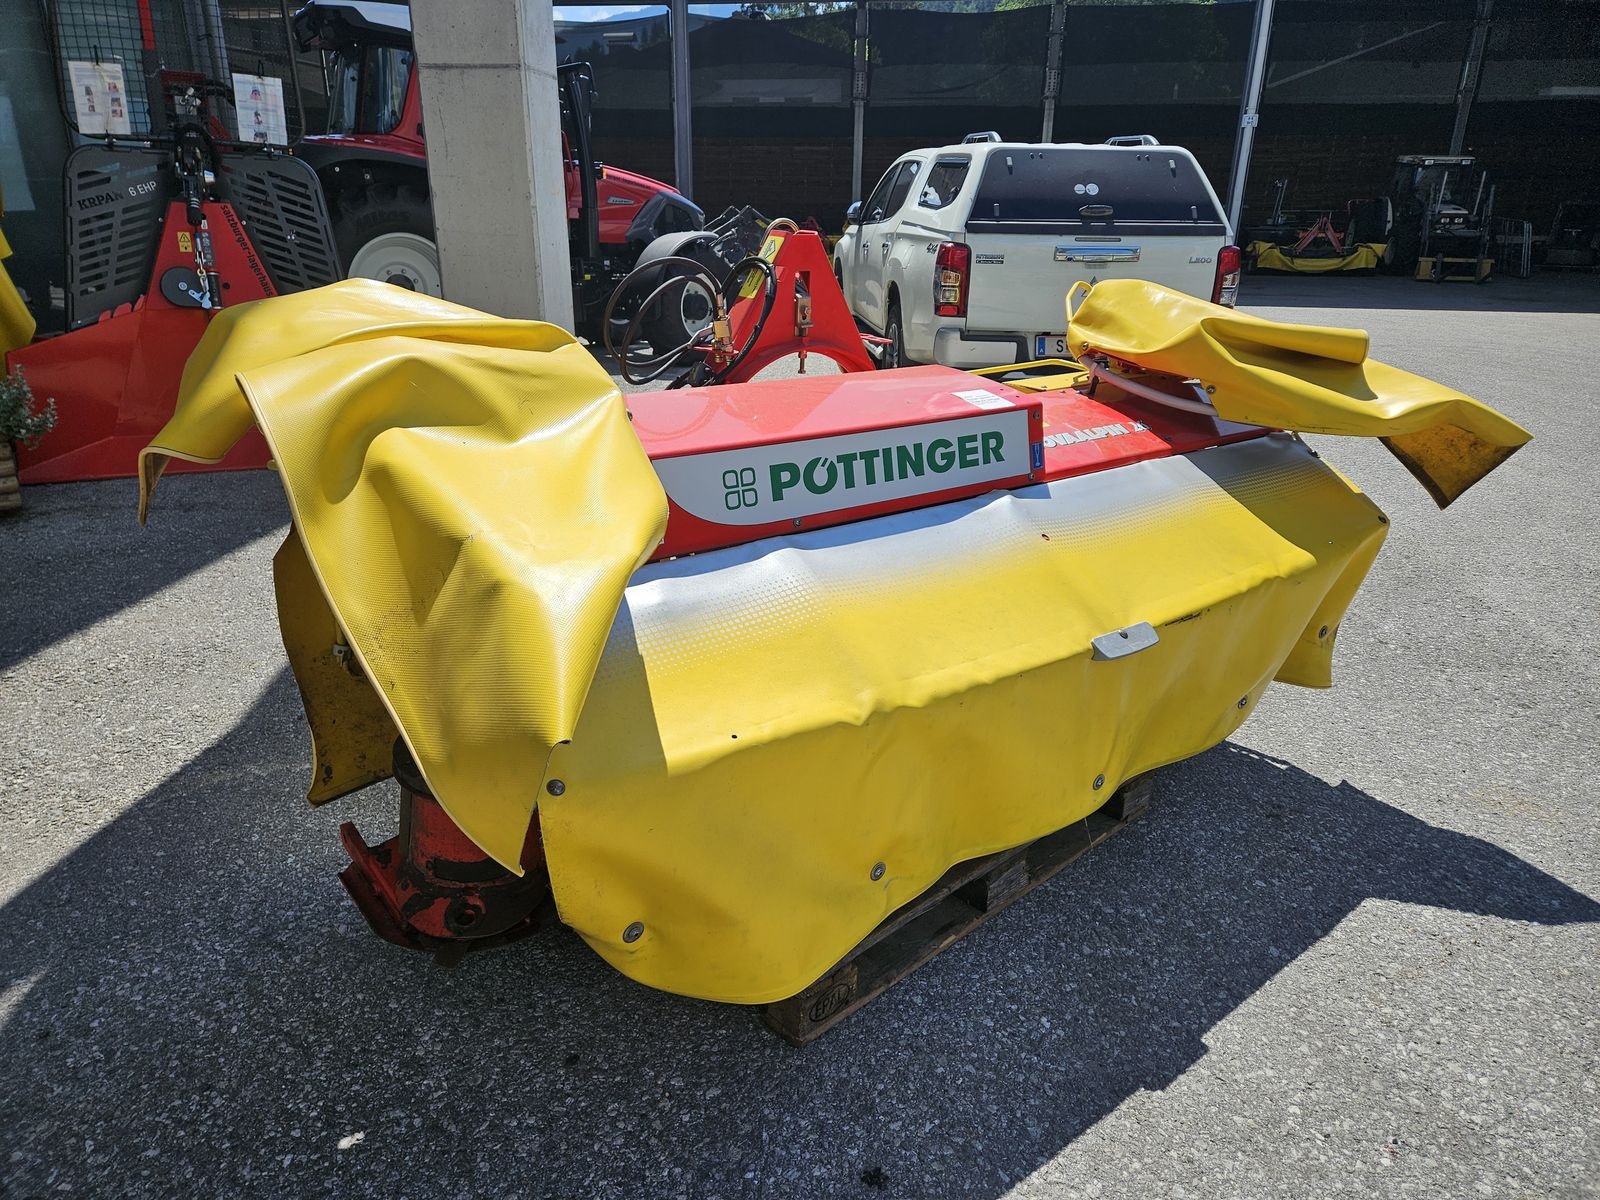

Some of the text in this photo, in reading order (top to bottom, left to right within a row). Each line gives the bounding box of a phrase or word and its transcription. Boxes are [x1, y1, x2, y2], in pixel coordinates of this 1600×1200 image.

[77, 180, 157, 211] KRPAN 6 EHP
[221, 204, 273, 297] salzburger-lagerhaus
[1056, 339, 1064, 353] S
[1043, 423, 1131, 448] OVAALPIN
[769, 430, 1006, 502] PÖTTINGER
